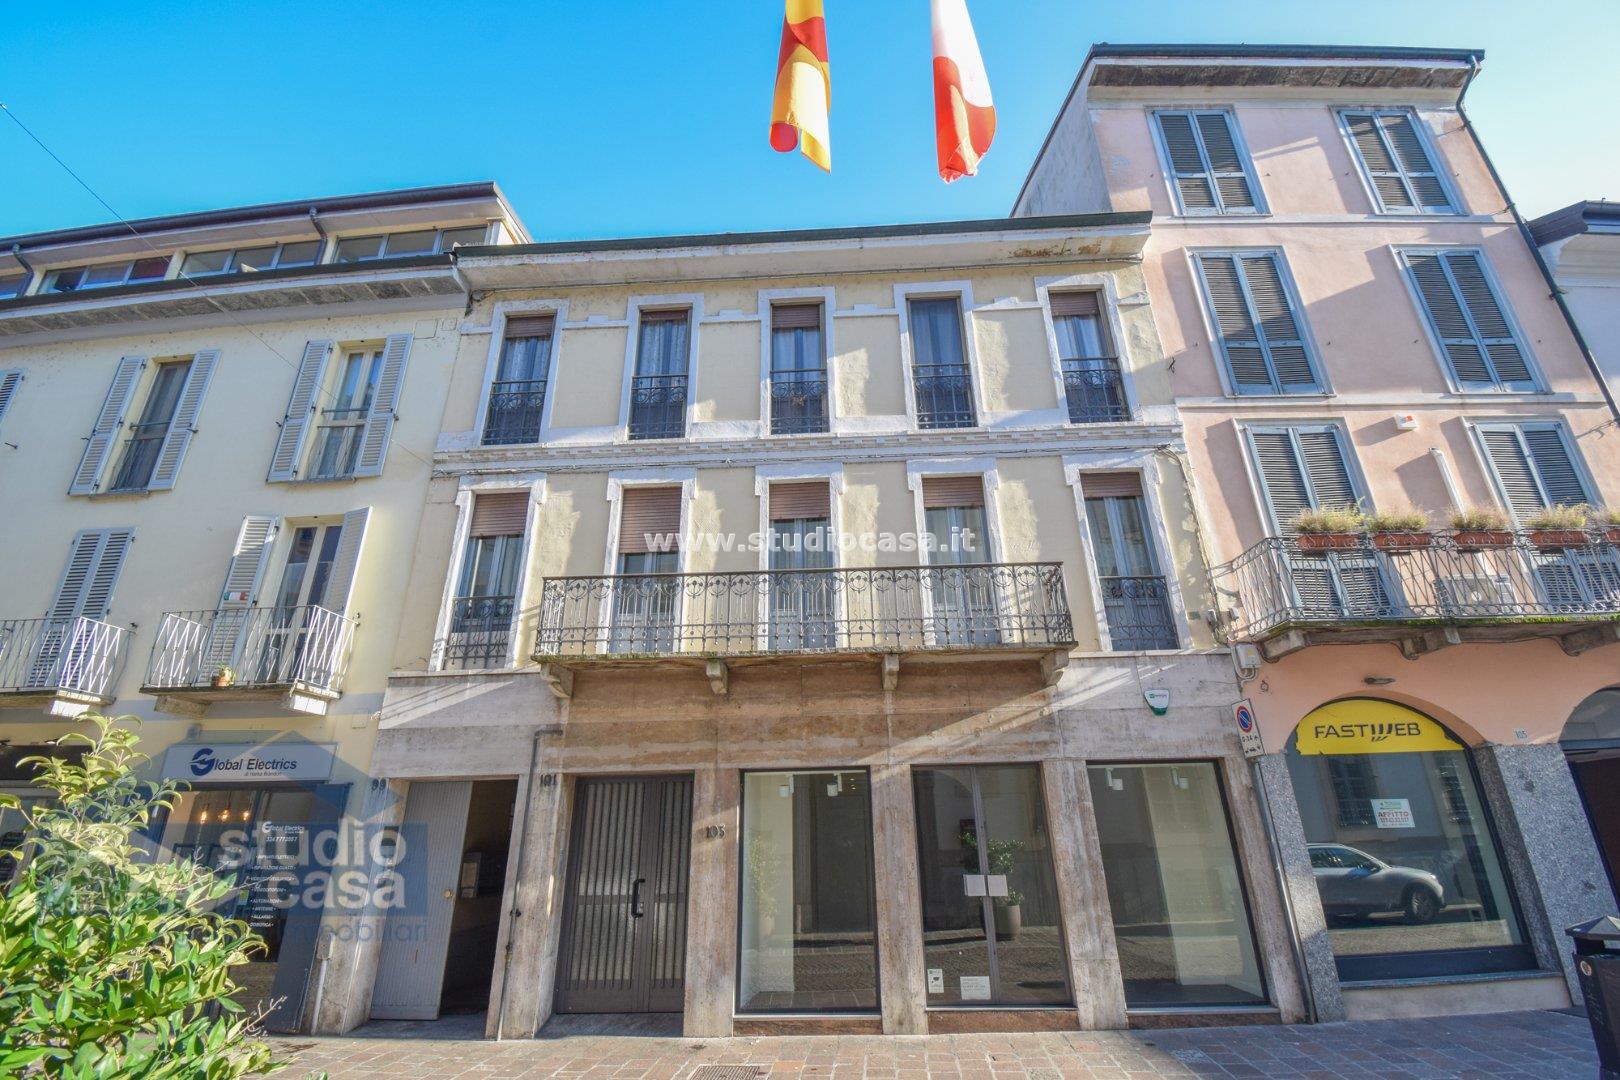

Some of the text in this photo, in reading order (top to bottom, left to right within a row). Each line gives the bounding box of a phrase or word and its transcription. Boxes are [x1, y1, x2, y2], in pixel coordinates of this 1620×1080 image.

[1314, 722, 1421, 742] FASTWEB
[189, 747, 298, 777] Global Electrics
[371, 778, 387, 791] 99
